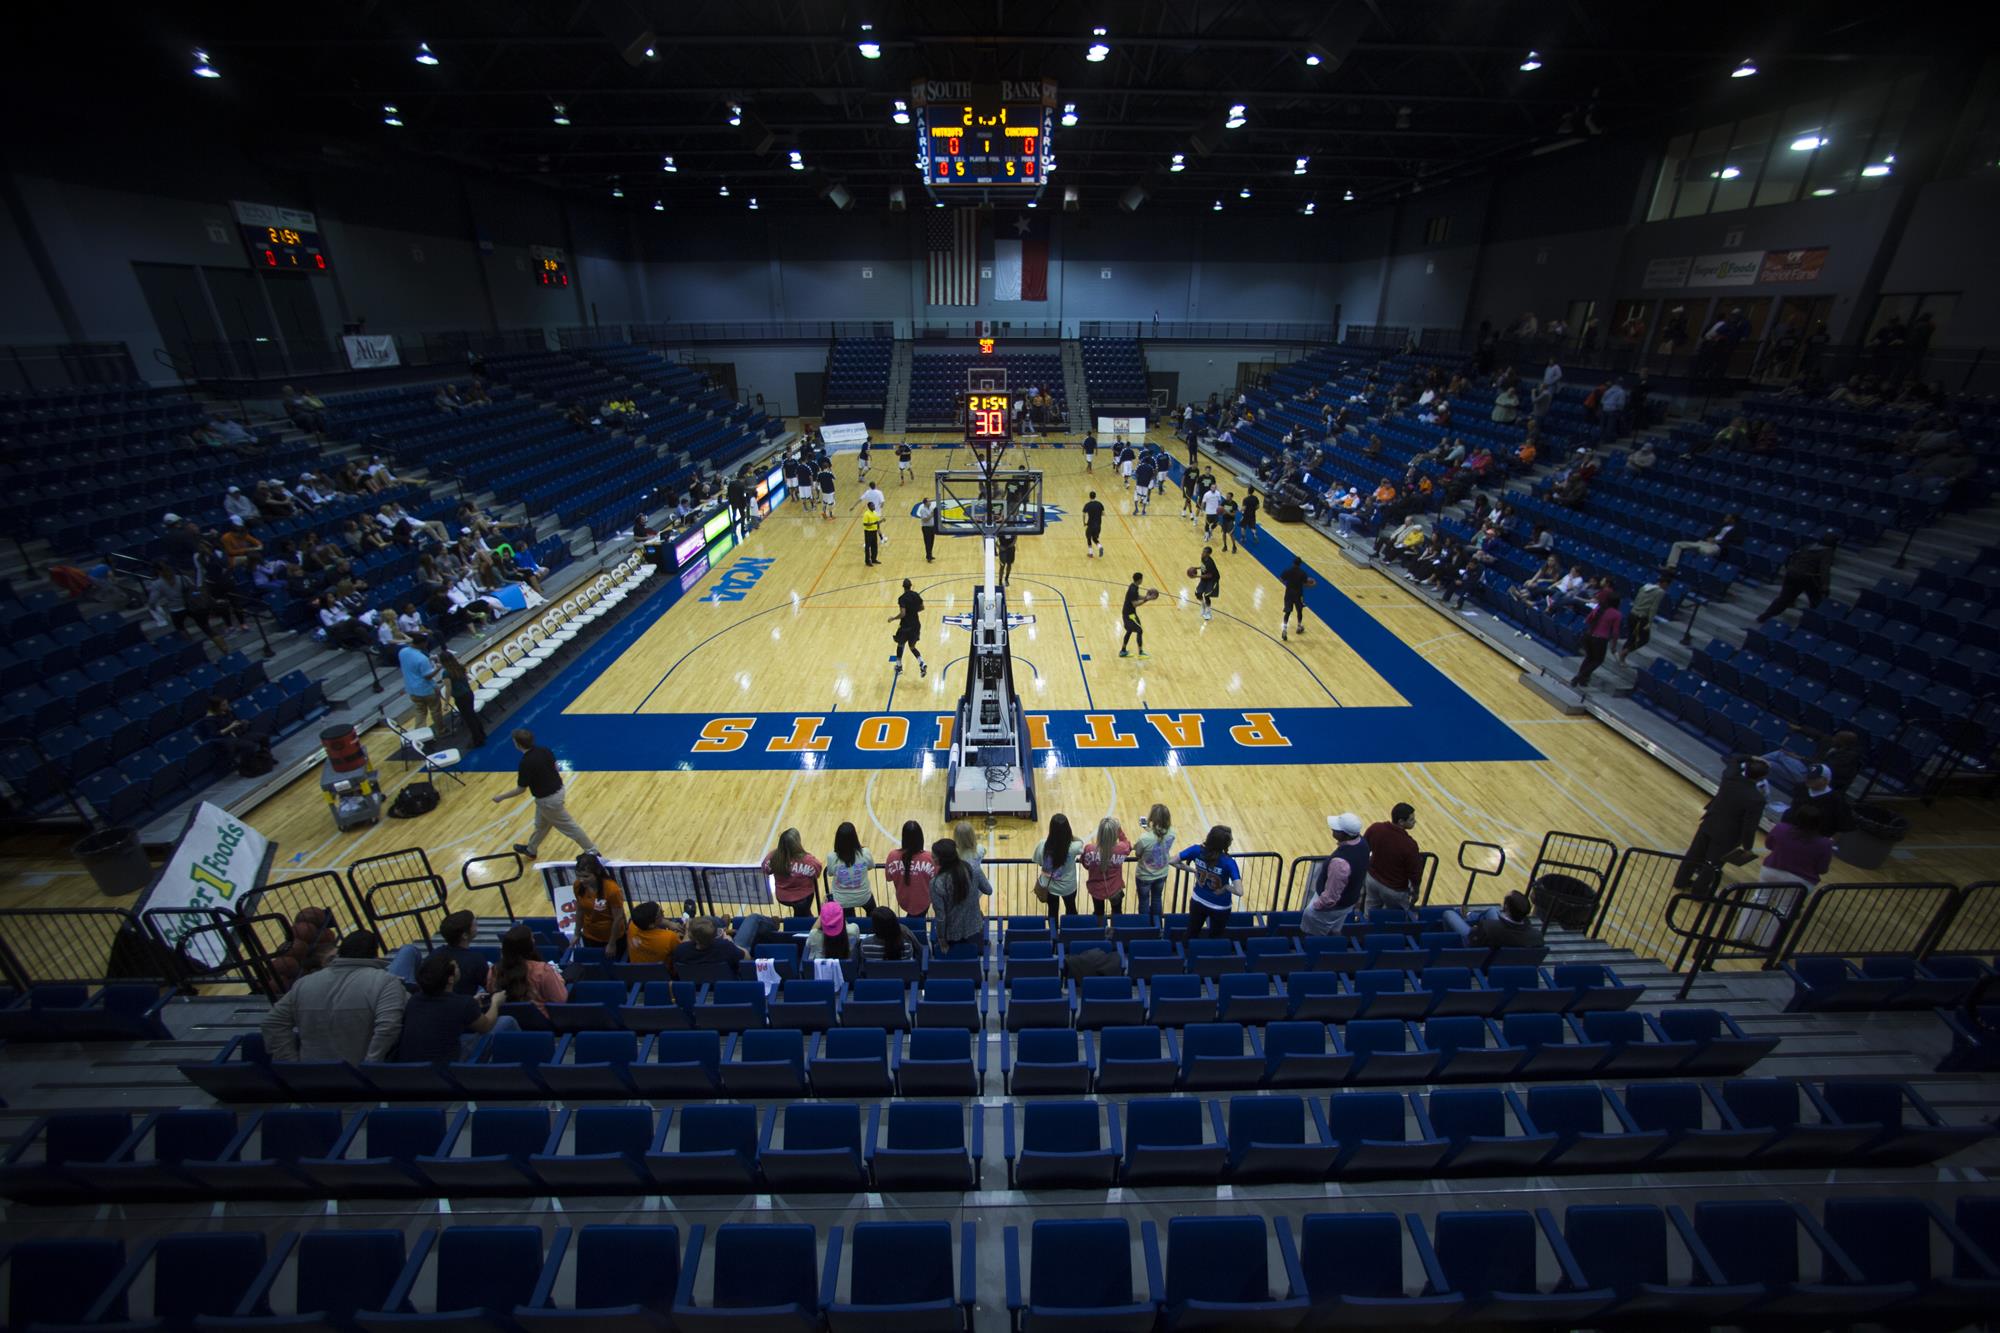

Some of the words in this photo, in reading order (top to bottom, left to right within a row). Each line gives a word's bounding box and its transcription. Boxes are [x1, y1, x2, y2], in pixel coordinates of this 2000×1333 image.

[927, 80, 972, 101] SOUTH
[1001, 80, 1041, 101] BANK
[915, 106, 931, 185] PATRIOTS
[949, 137, 960, 155] 0
[984, 140, 990, 153] 1
[1024, 137, 1035, 155] 0
[1039, 106, 1053, 185] PATRIOTS
[939, 161, 949, 176] 0
[1025, 161, 1035, 176] 0
[1728, 262, 1756, 274] Foods
[981, 345, 993, 354] 30
[969, 396, 1007, 411] 21:54
[976, 411, 1002, 435] 30
[698, 557, 776, 602] NCAA
[202, 822, 245, 878] Foods
[190, 862, 237, 901] 1
